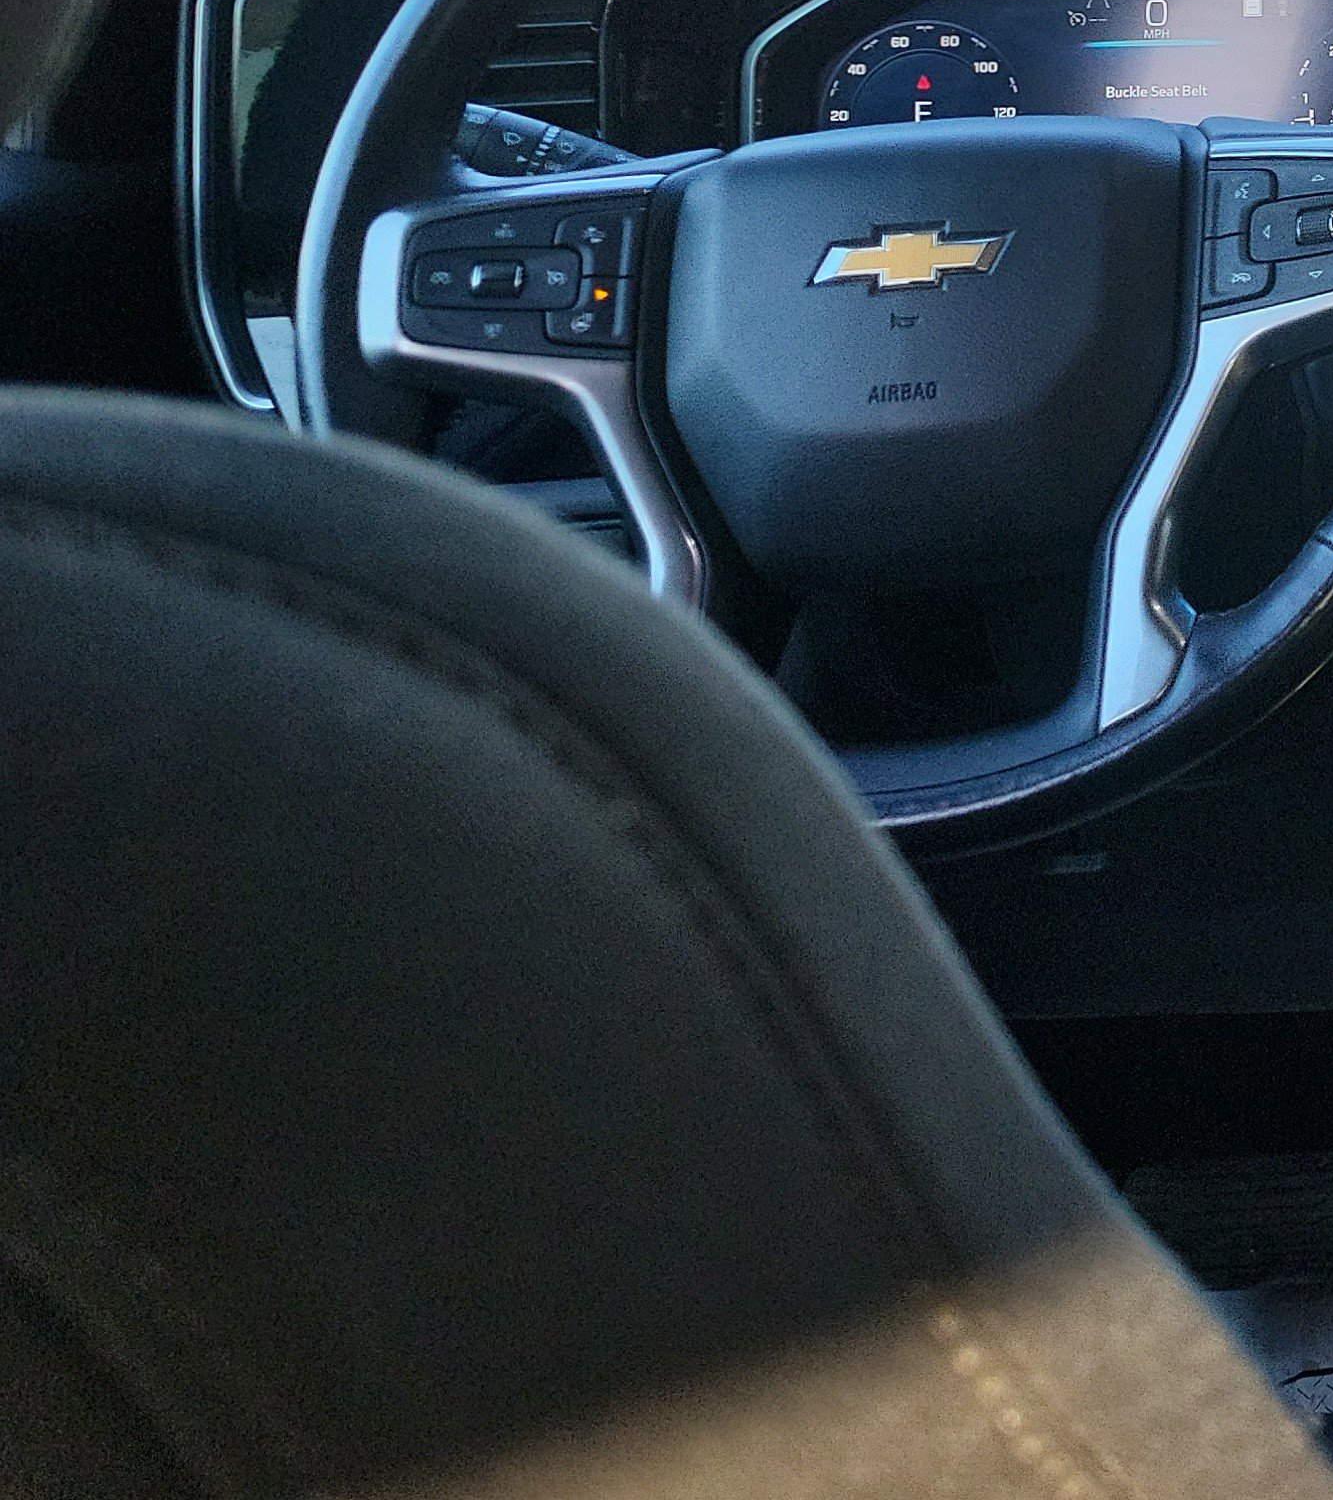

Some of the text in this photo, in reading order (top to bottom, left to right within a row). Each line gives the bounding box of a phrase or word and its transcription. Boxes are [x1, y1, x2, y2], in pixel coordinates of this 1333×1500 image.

[1144, 28, 1170, 39] MPH
[890, 36, 910, 48] 60
[940, 35, 960, 47] 80
[847, 63, 867, 75] 40
[973, 62, 998, 73] 100
[1106, 84, 1208, 98] Buckle Seat Belt
[1302, 93, 1308, 104] 1
[829, 110, 849, 122] 20
[992, 107, 1016, 119] 120
[868, 381, 937, 404] AIRBAG
